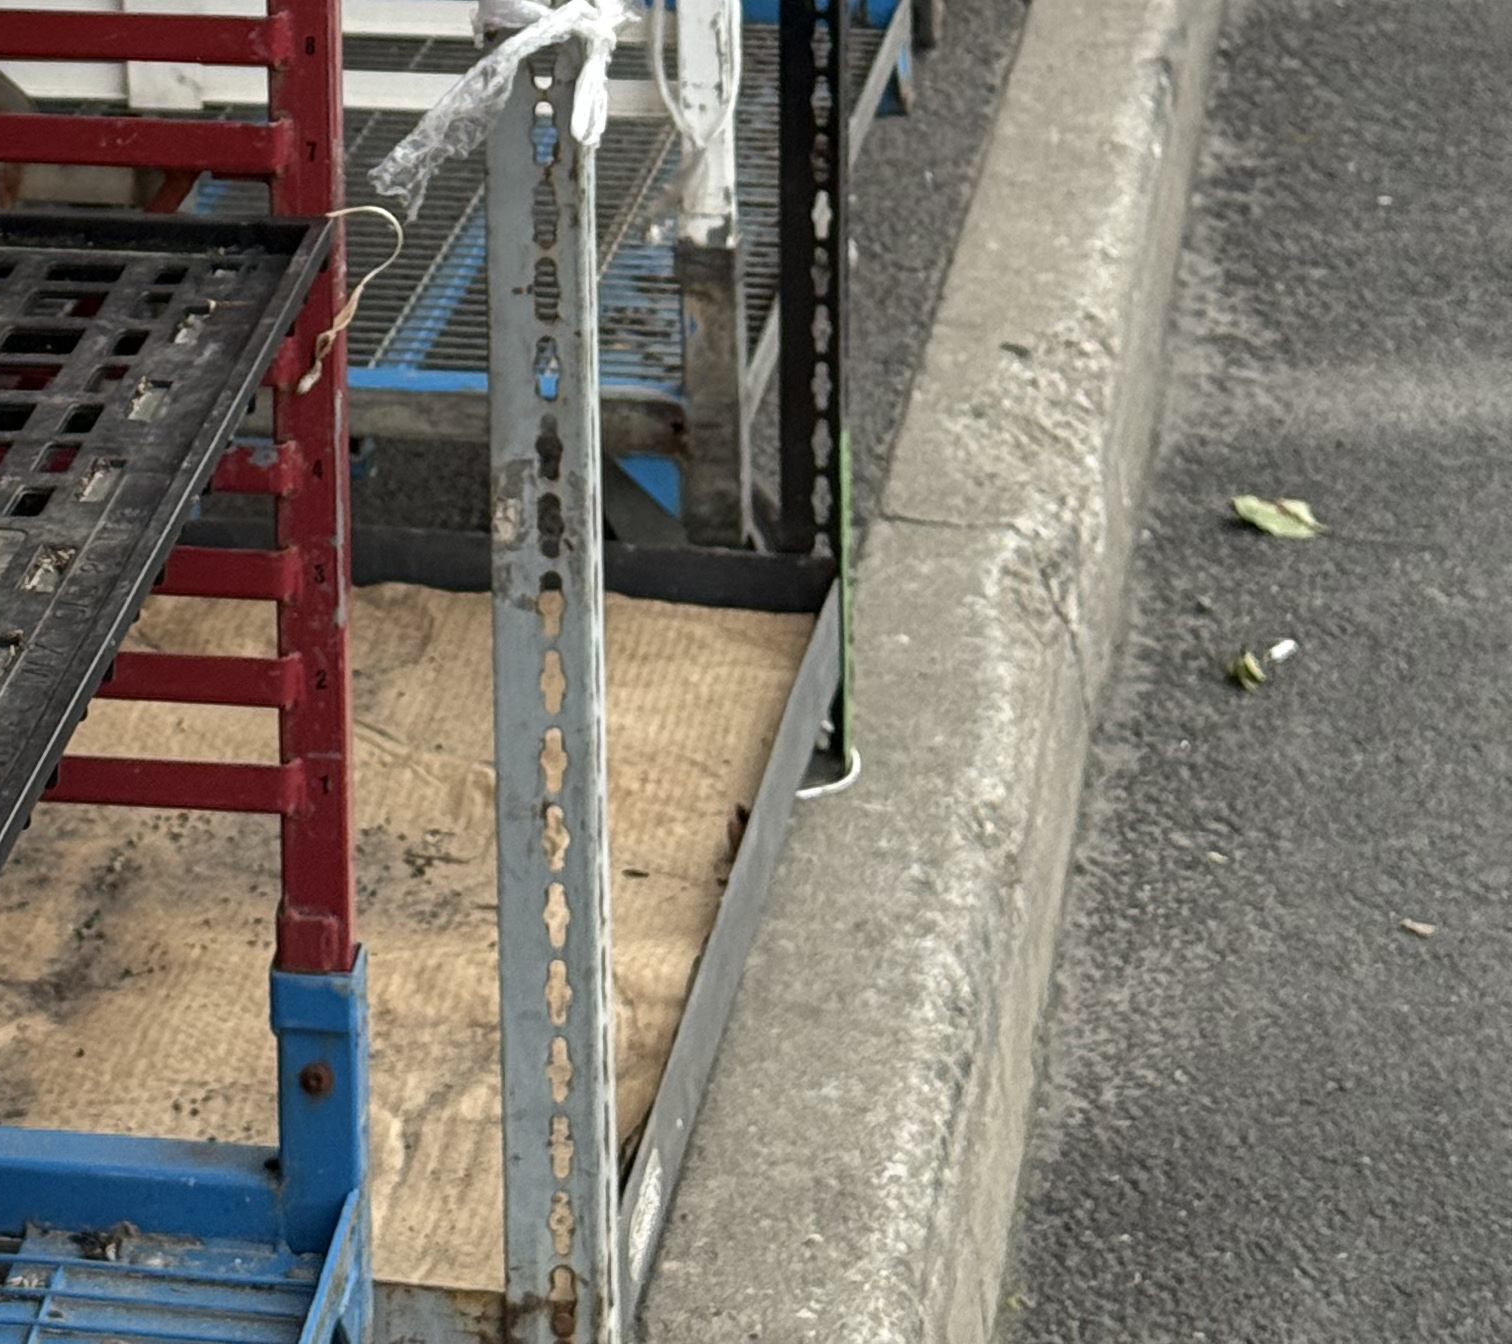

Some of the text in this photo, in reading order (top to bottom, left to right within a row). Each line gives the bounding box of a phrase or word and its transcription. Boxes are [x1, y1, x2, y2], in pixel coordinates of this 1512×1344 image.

[305, 37, 315, 55] 8
[307, 141, 317, 161] 7
[312, 460, 323, 478] 4
[315, 564, 325, 583] 3
[316, 671, 326, 689] 2
[321, 776, 328, 794] 1
